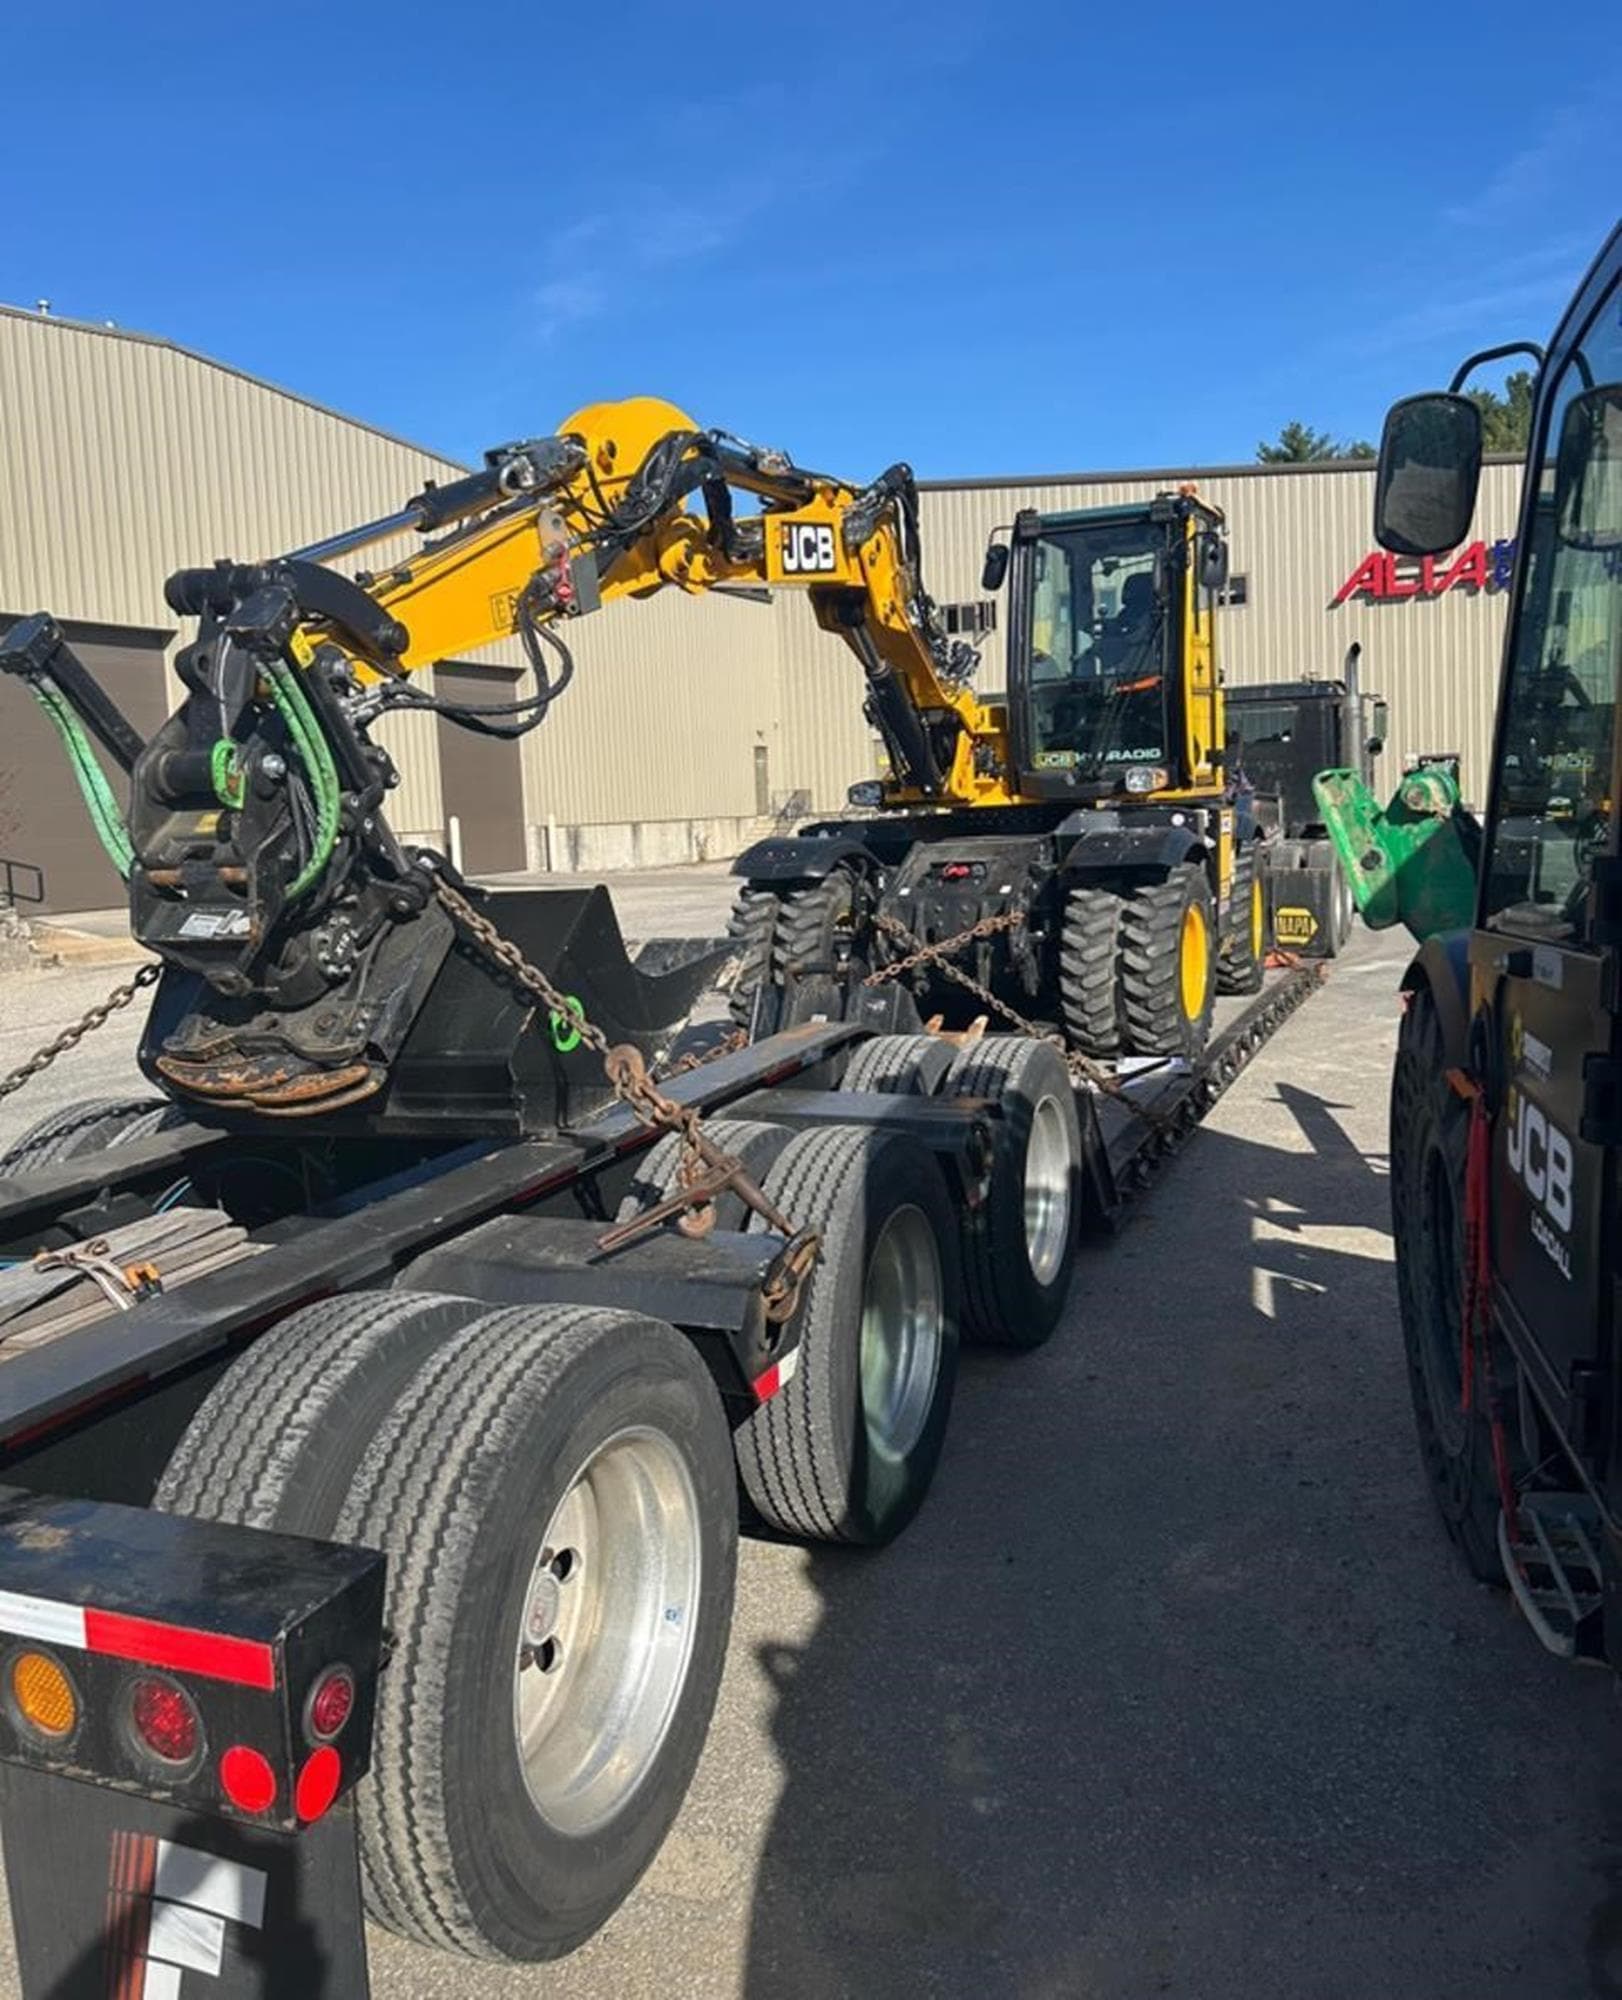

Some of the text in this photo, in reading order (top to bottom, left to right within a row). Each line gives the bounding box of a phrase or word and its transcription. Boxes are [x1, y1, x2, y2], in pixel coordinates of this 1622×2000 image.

[783, 525, 835, 571] JCB
[1276, 916, 1312, 937] NAPA
[1507, 1094, 1573, 1233] JCB
